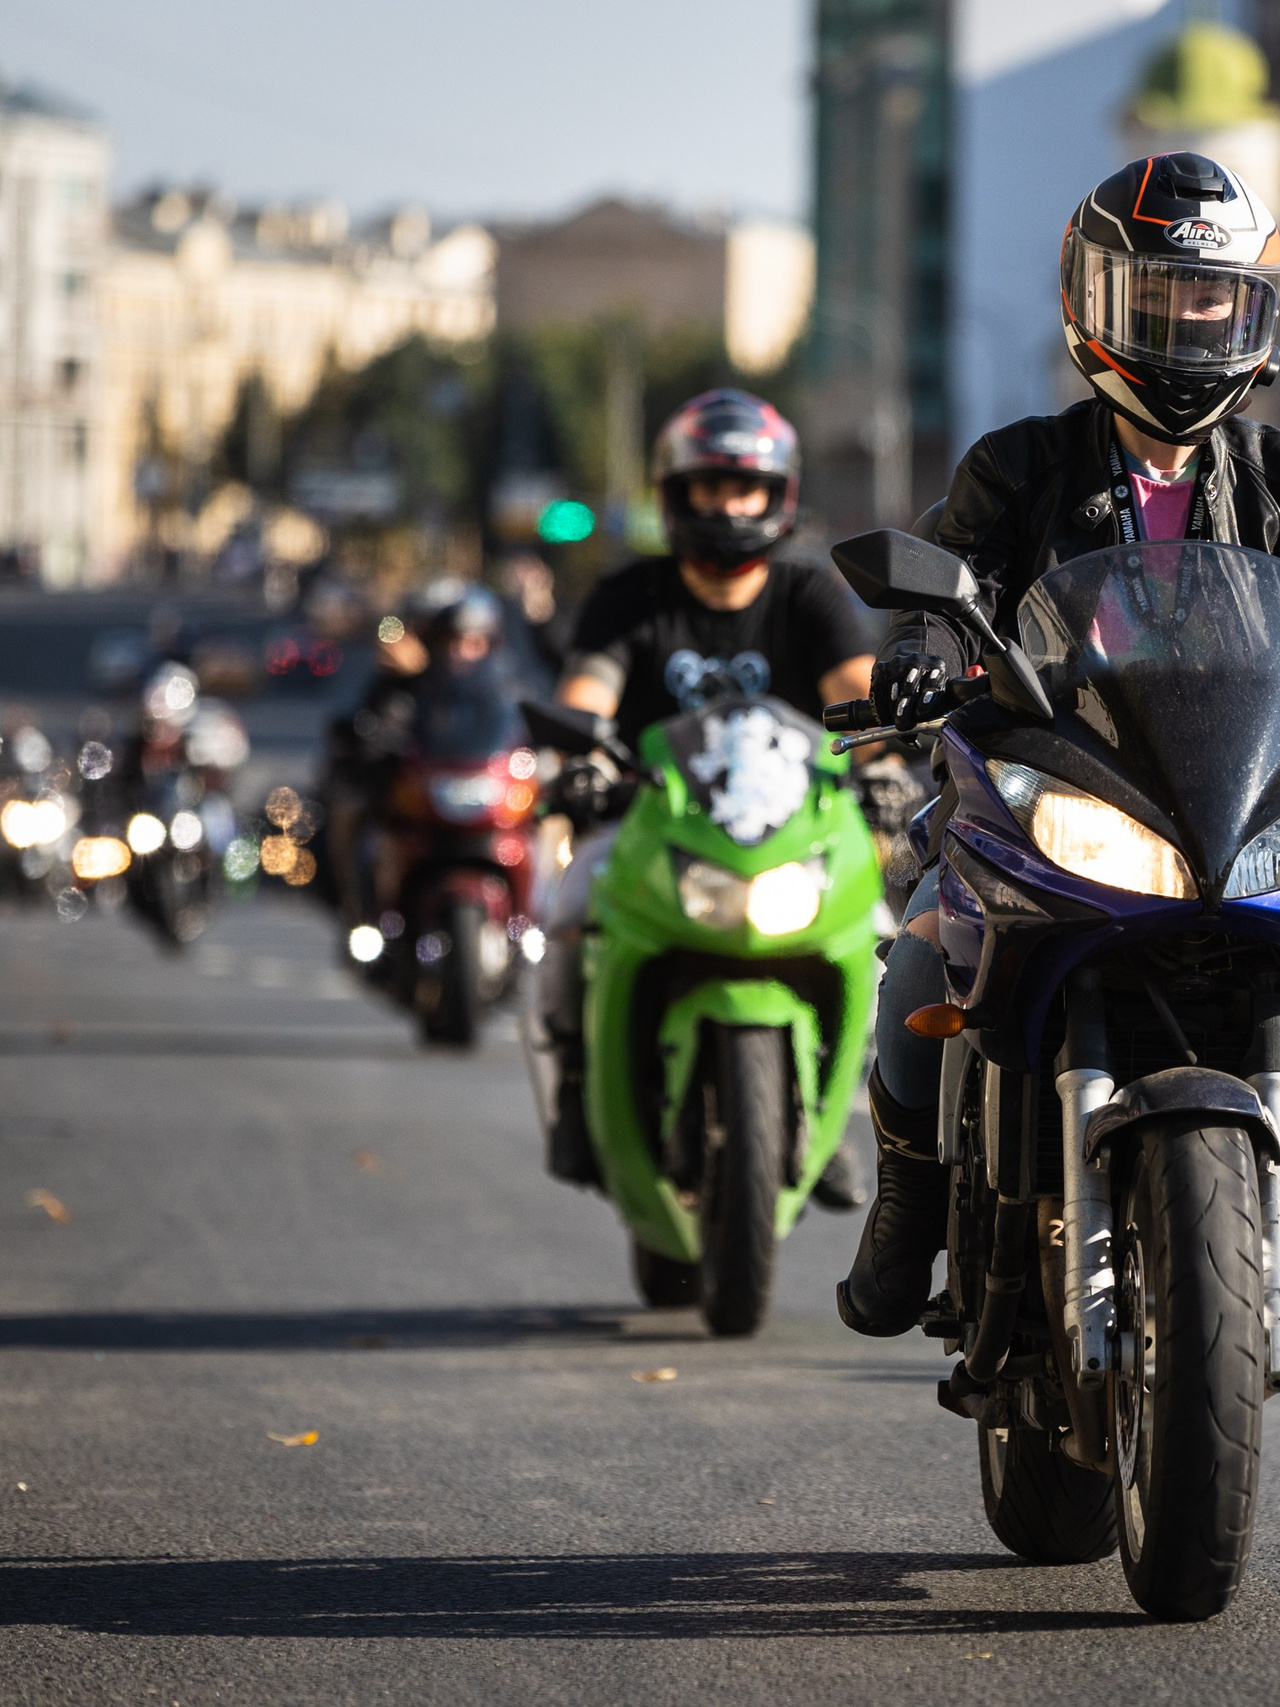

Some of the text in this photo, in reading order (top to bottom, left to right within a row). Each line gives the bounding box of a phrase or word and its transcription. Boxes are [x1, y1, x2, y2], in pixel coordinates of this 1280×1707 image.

[1171, 221, 1228, 244] Airoh
[1120, 507, 1136, 544] YAMAHA
[1191, 496, 1205, 531] YAMAHA
